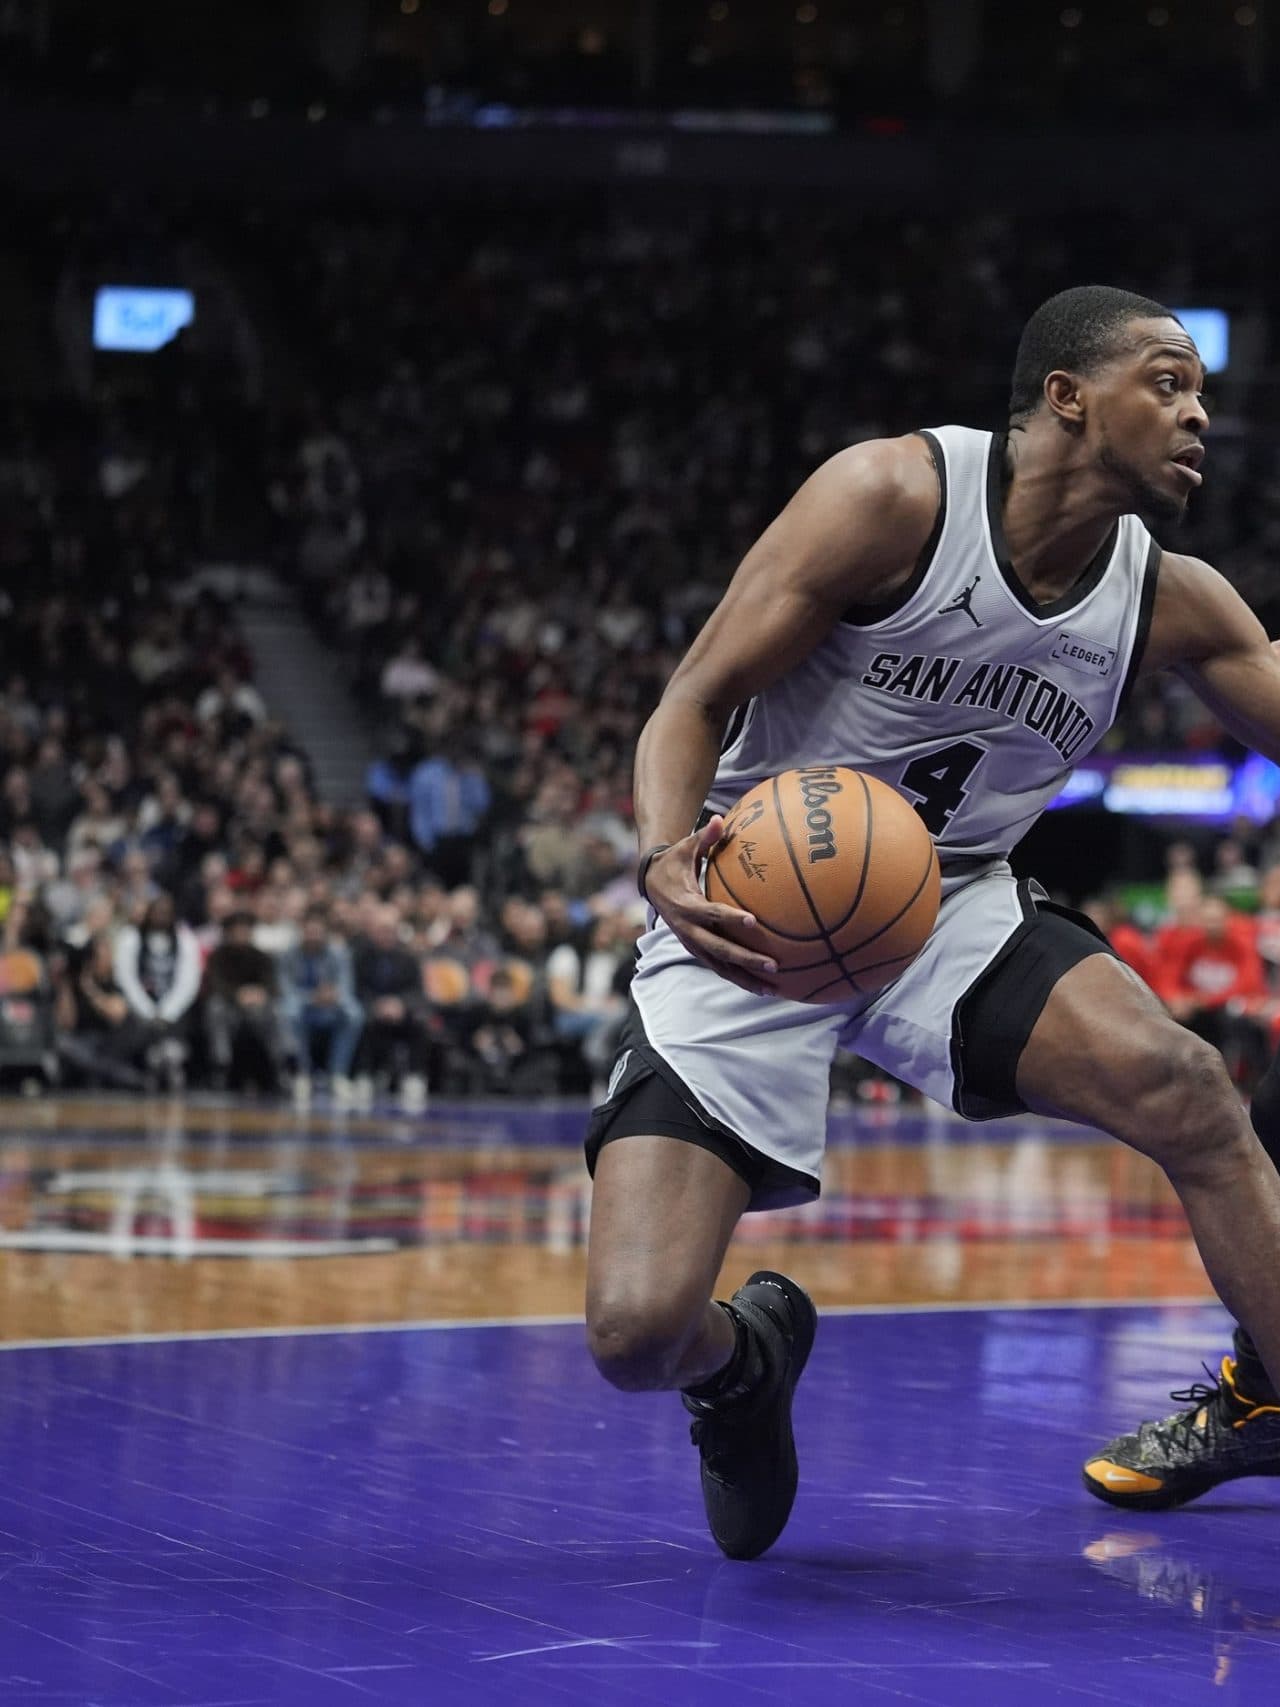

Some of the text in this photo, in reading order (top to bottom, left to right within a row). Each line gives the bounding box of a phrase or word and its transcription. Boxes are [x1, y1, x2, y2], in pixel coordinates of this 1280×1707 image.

[1062, 642, 1107, 667] LEDGER
[861, 652, 1097, 764] SAN ANTONIO
[898, 739, 989, 839] 4
